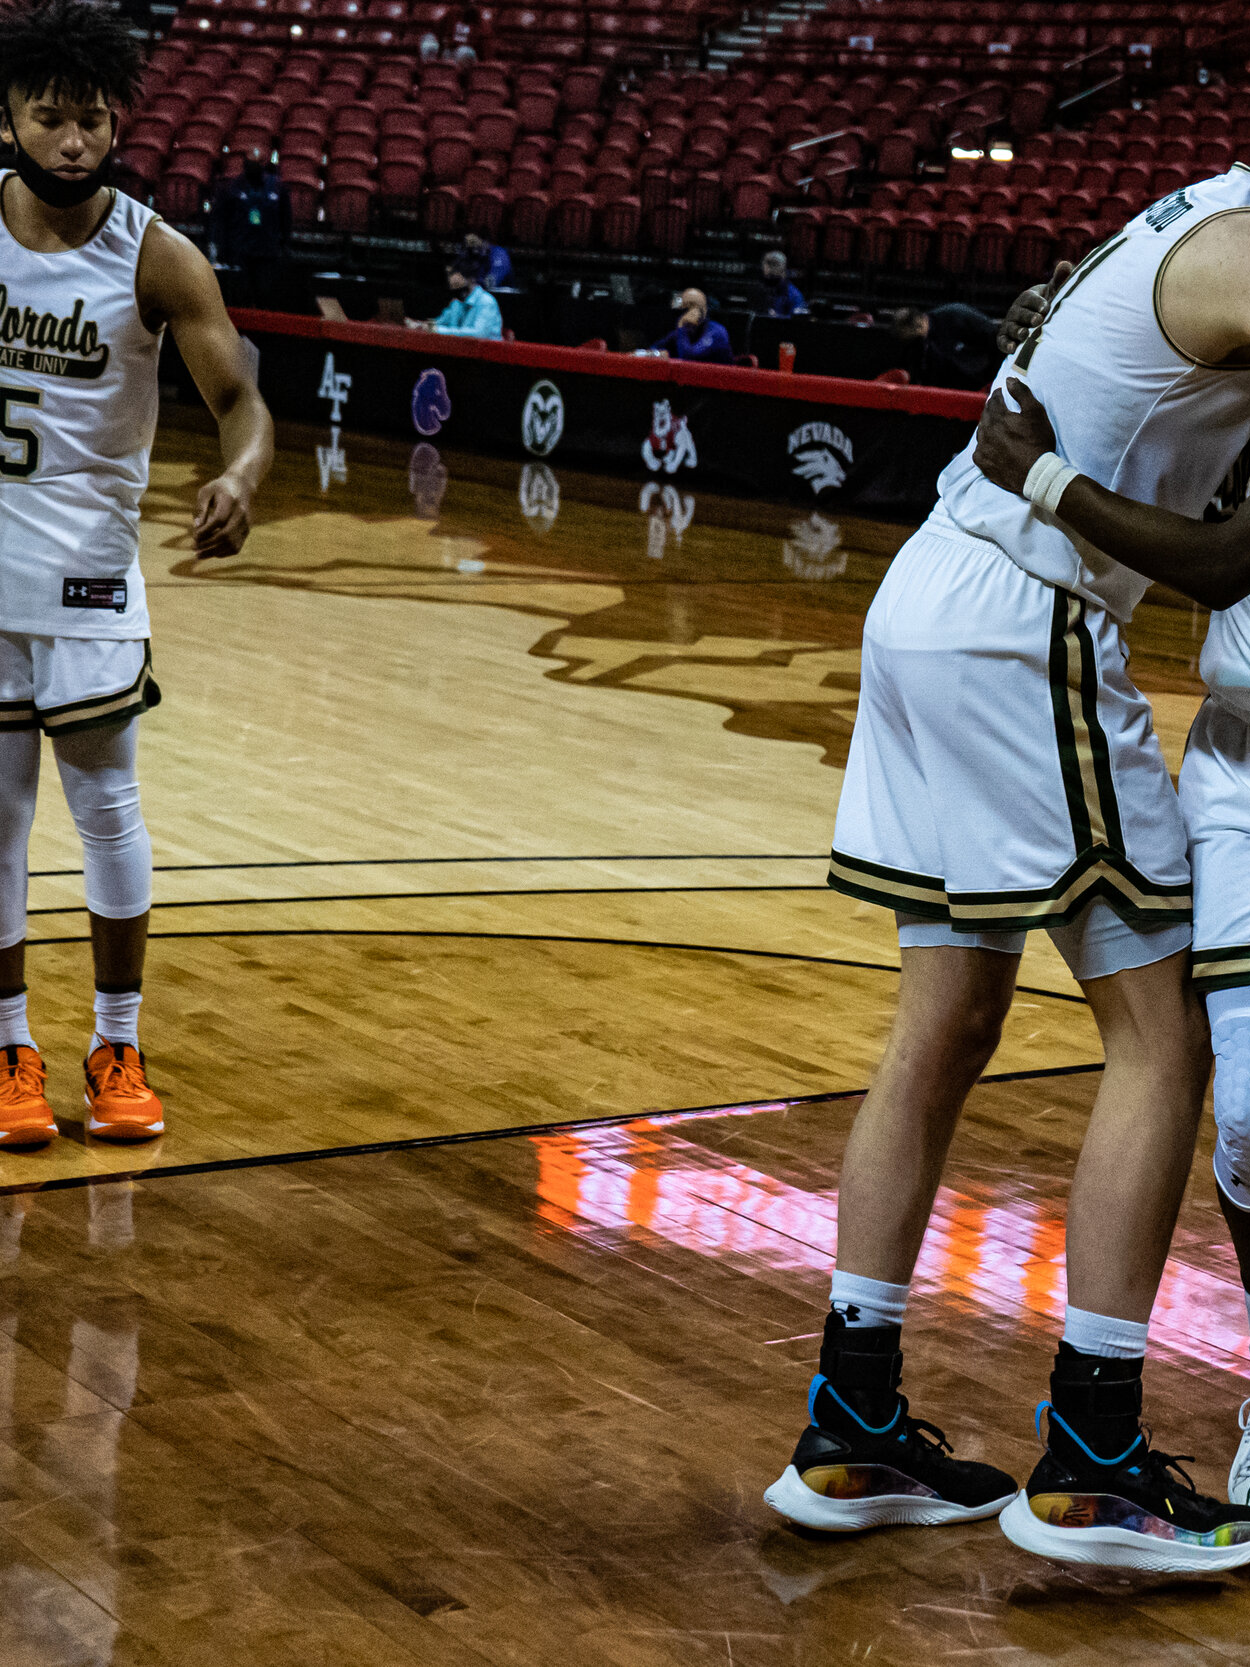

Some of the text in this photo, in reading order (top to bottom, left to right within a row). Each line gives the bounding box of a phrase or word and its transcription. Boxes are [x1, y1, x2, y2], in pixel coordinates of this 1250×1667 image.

[0, 348, 68, 375] ATE UNIV
[0, 383, 43, 482] 5
[787, 421, 853, 464] NEVADA
